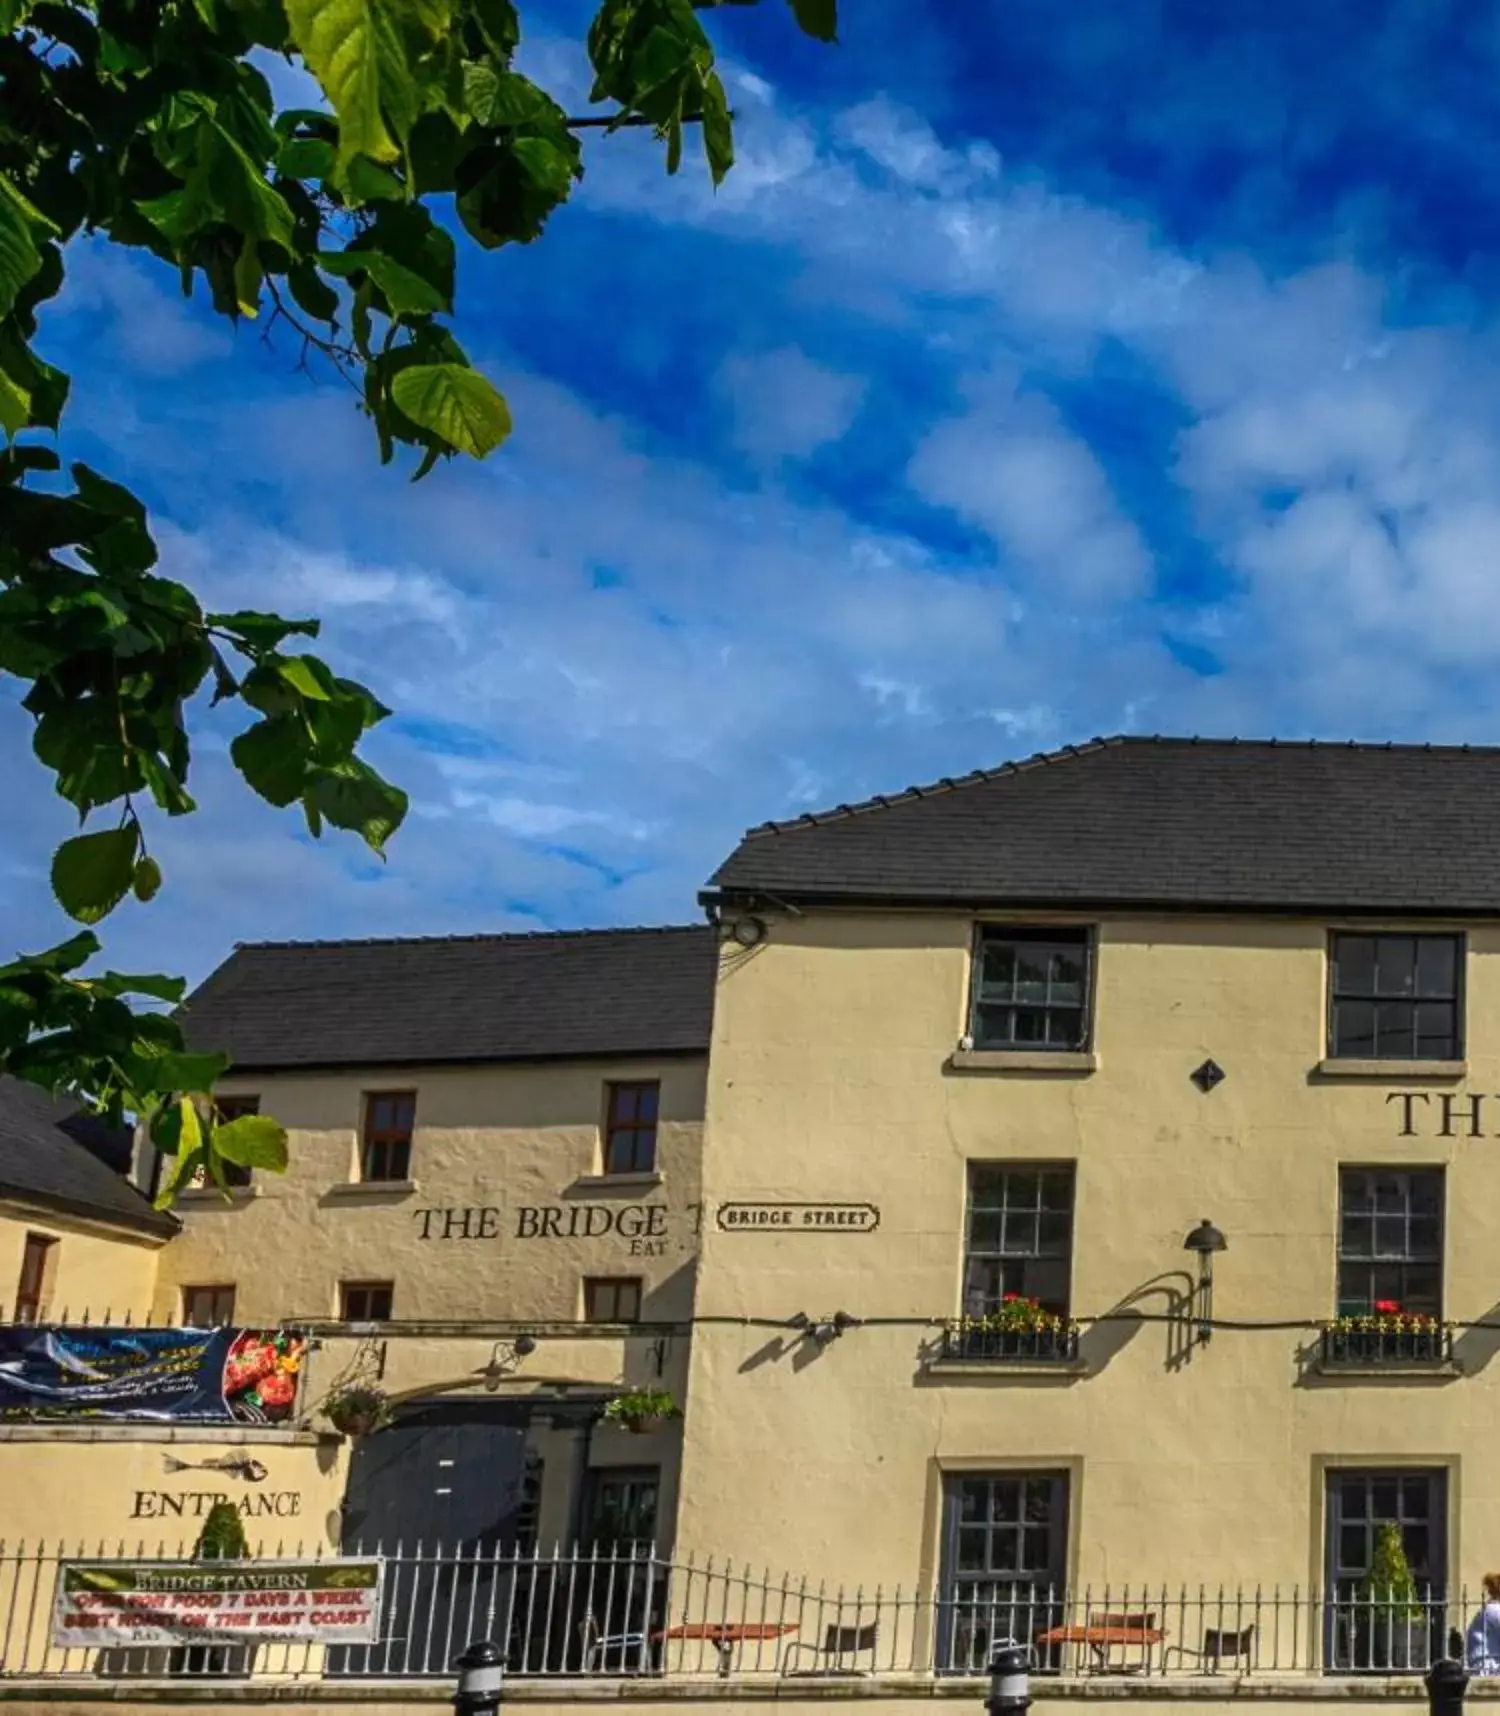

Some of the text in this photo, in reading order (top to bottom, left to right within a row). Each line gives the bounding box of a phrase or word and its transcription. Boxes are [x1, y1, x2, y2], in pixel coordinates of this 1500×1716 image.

[413, 1206, 500, 1239] THE
[514, 1205, 669, 1239] BRIDGE
[727, 1211, 869, 1225] BRIDGE STREET
[628, 1239, 669, 1257] EAT
[129, 1490, 301, 1519] ENTRANCE
[135, 1573, 308, 1590] BRIDGE TAVERN
[243, 1592, 291, 1607] DAYS
[293, 1592, 310, 1606] A
